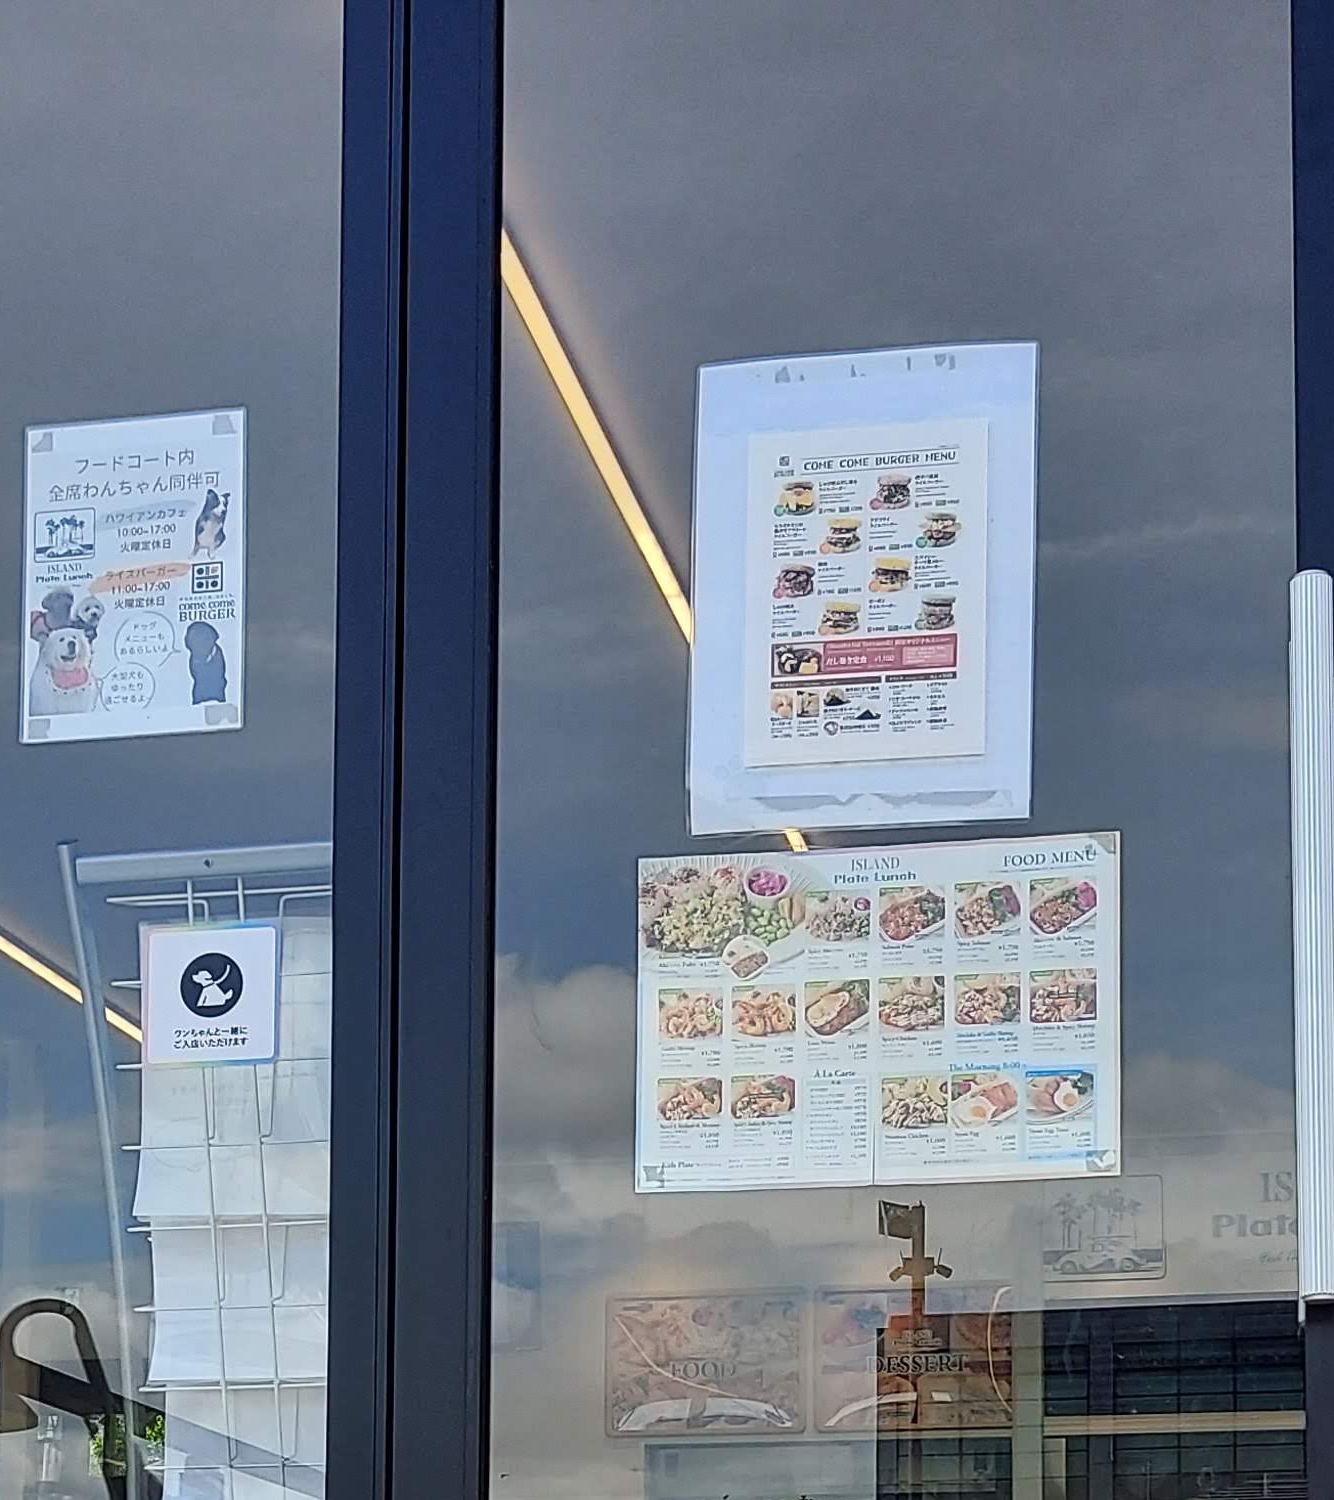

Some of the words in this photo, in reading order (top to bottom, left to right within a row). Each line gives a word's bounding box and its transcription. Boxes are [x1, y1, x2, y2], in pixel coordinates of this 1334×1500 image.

[75, 448, 194, 474] フードコート内
[804, 460, 834, 471] COME
[839, 457, 870, 469] COME
[875, 453, 919, 466] BURGER
[925, 451, 956, 462] MENU
[49, 471, 219, 502] 全席わんちゃん同伴可
[179, 608, 236, 622] BURGER
[851, 857, 900, 872] ISLAND
[1003, 854, 1046, 868] FOOD
[1051, 849, 1098, 865] MENU
[174, 1026, 248, 1038] ワンちゃんと一緒に
[173, 1037, 248, 1049] ご入店いただけます
[868, 1353, 969, 1375] DESSERT
